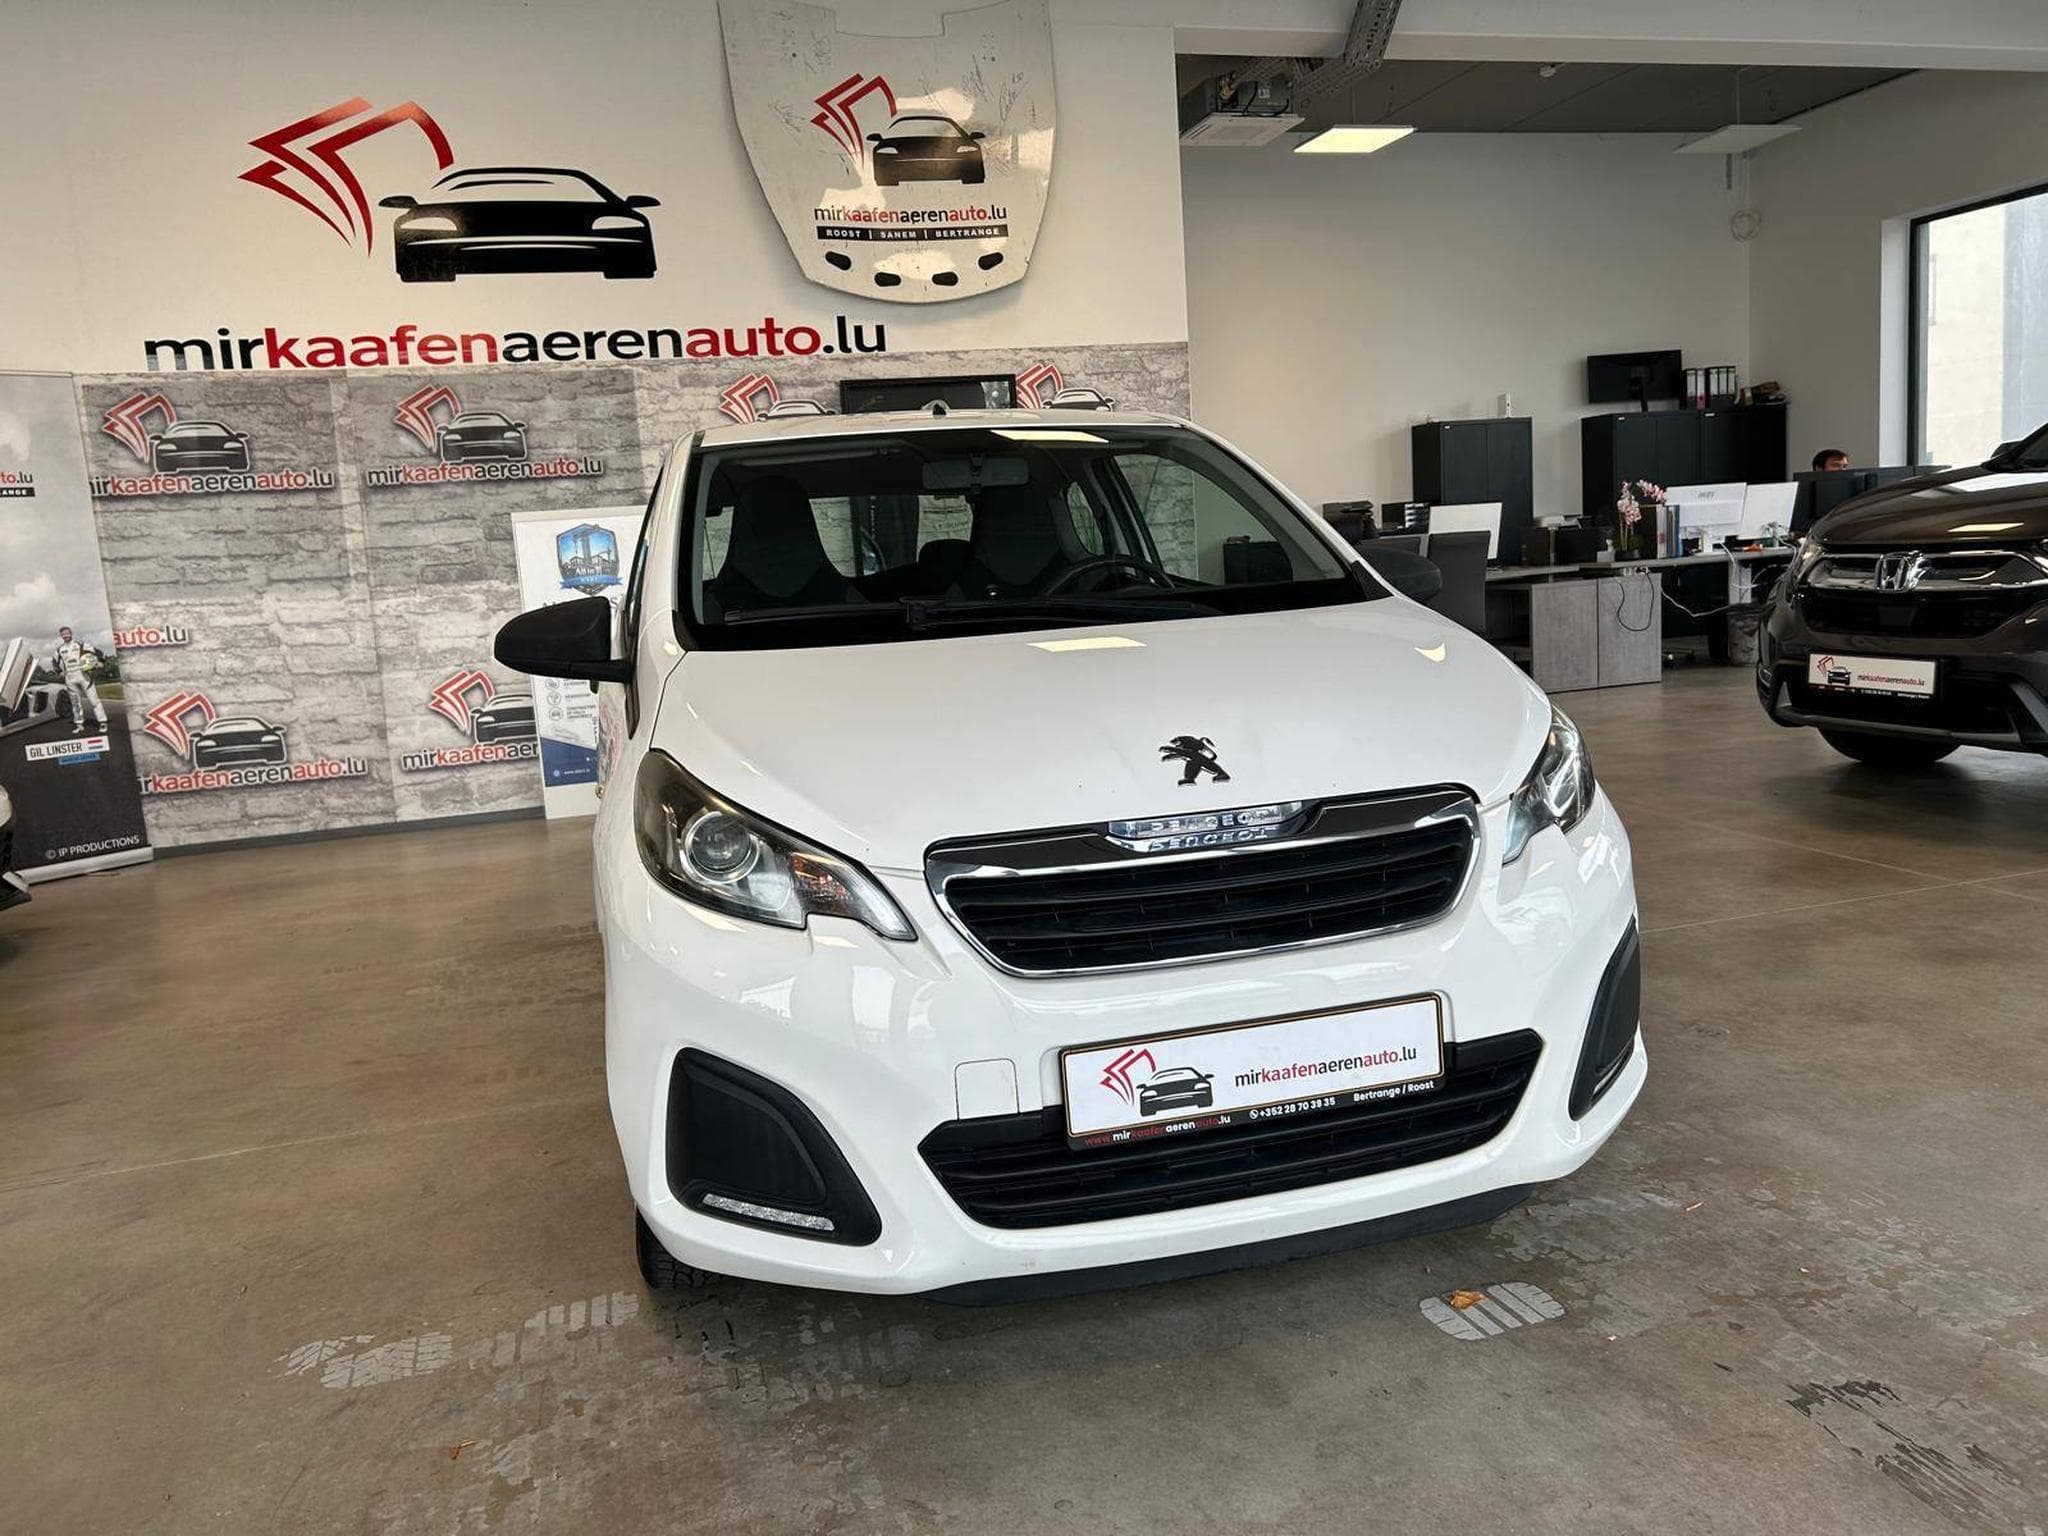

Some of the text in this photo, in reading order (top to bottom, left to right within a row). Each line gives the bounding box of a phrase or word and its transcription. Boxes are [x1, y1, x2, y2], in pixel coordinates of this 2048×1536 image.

[814, 204, 1007, 225] mirkaafenaerenauto.lu
[826, 229, 861, 238] ROOST
[880, 231, 917, 239] SANEM
[935, 227, 1000, 238] BERTRANGE
[143, 315, 887, 372] mirkaafenaerenauto.lu
[367, 457, 602, 486] mirkaafenaerenauto.lu
[29, 747, 45, 759] GIL
[46, 742, 83, 756] LINSTER
[58, 847, 68, 857] IP
[70, 834, 140, 855] PRODUCTIONS
[1234, 1046, 1417, 1087] mirkaafenaerenauto.lu
[1285, 1105, 1297, 1114] 28
[1298, 1103, 1310, 1112] 70
[1324, 1098, 1336, 1107] 35
[1353, 1087, 1401, 1103] Bertrange
[1407, 1080, 1435, 1094] Roost
